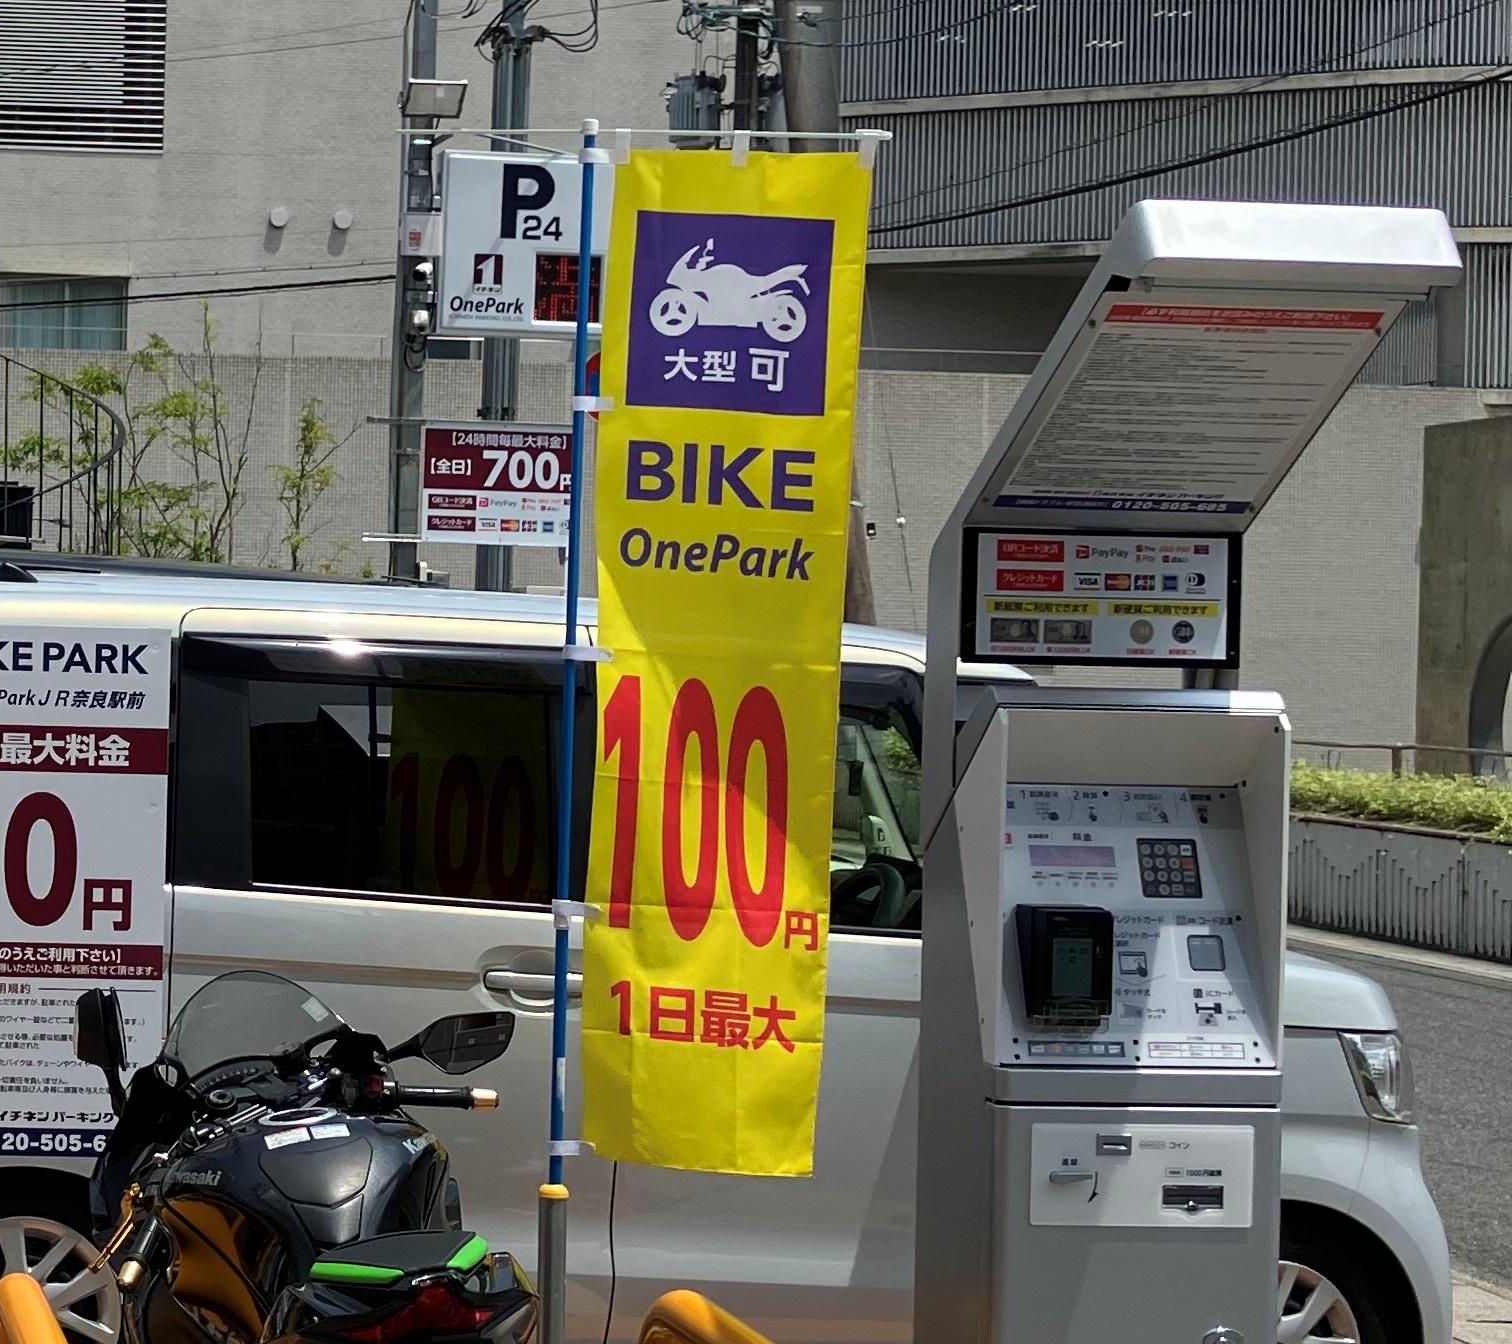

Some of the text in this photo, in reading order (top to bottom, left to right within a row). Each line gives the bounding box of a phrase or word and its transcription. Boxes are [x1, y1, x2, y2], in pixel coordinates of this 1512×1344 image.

[500, 163, 556, 239] P
[522, 215, 563, 241] 24
[450, 295, 525, 315] OnePark
[430, 457, 472, 476] 【全日】
[625, 439, 817, 513] BIKE
[490, 498, 518, 509] PayPay
[619, 527, 816, 582] OnePark
[1091, 547, 1130, 559] PayPay
[1079, 576, 1099, 585] VISA
[42, 642, 149, 675] PARK
[610, 979, 797, 1054] 1日最大
